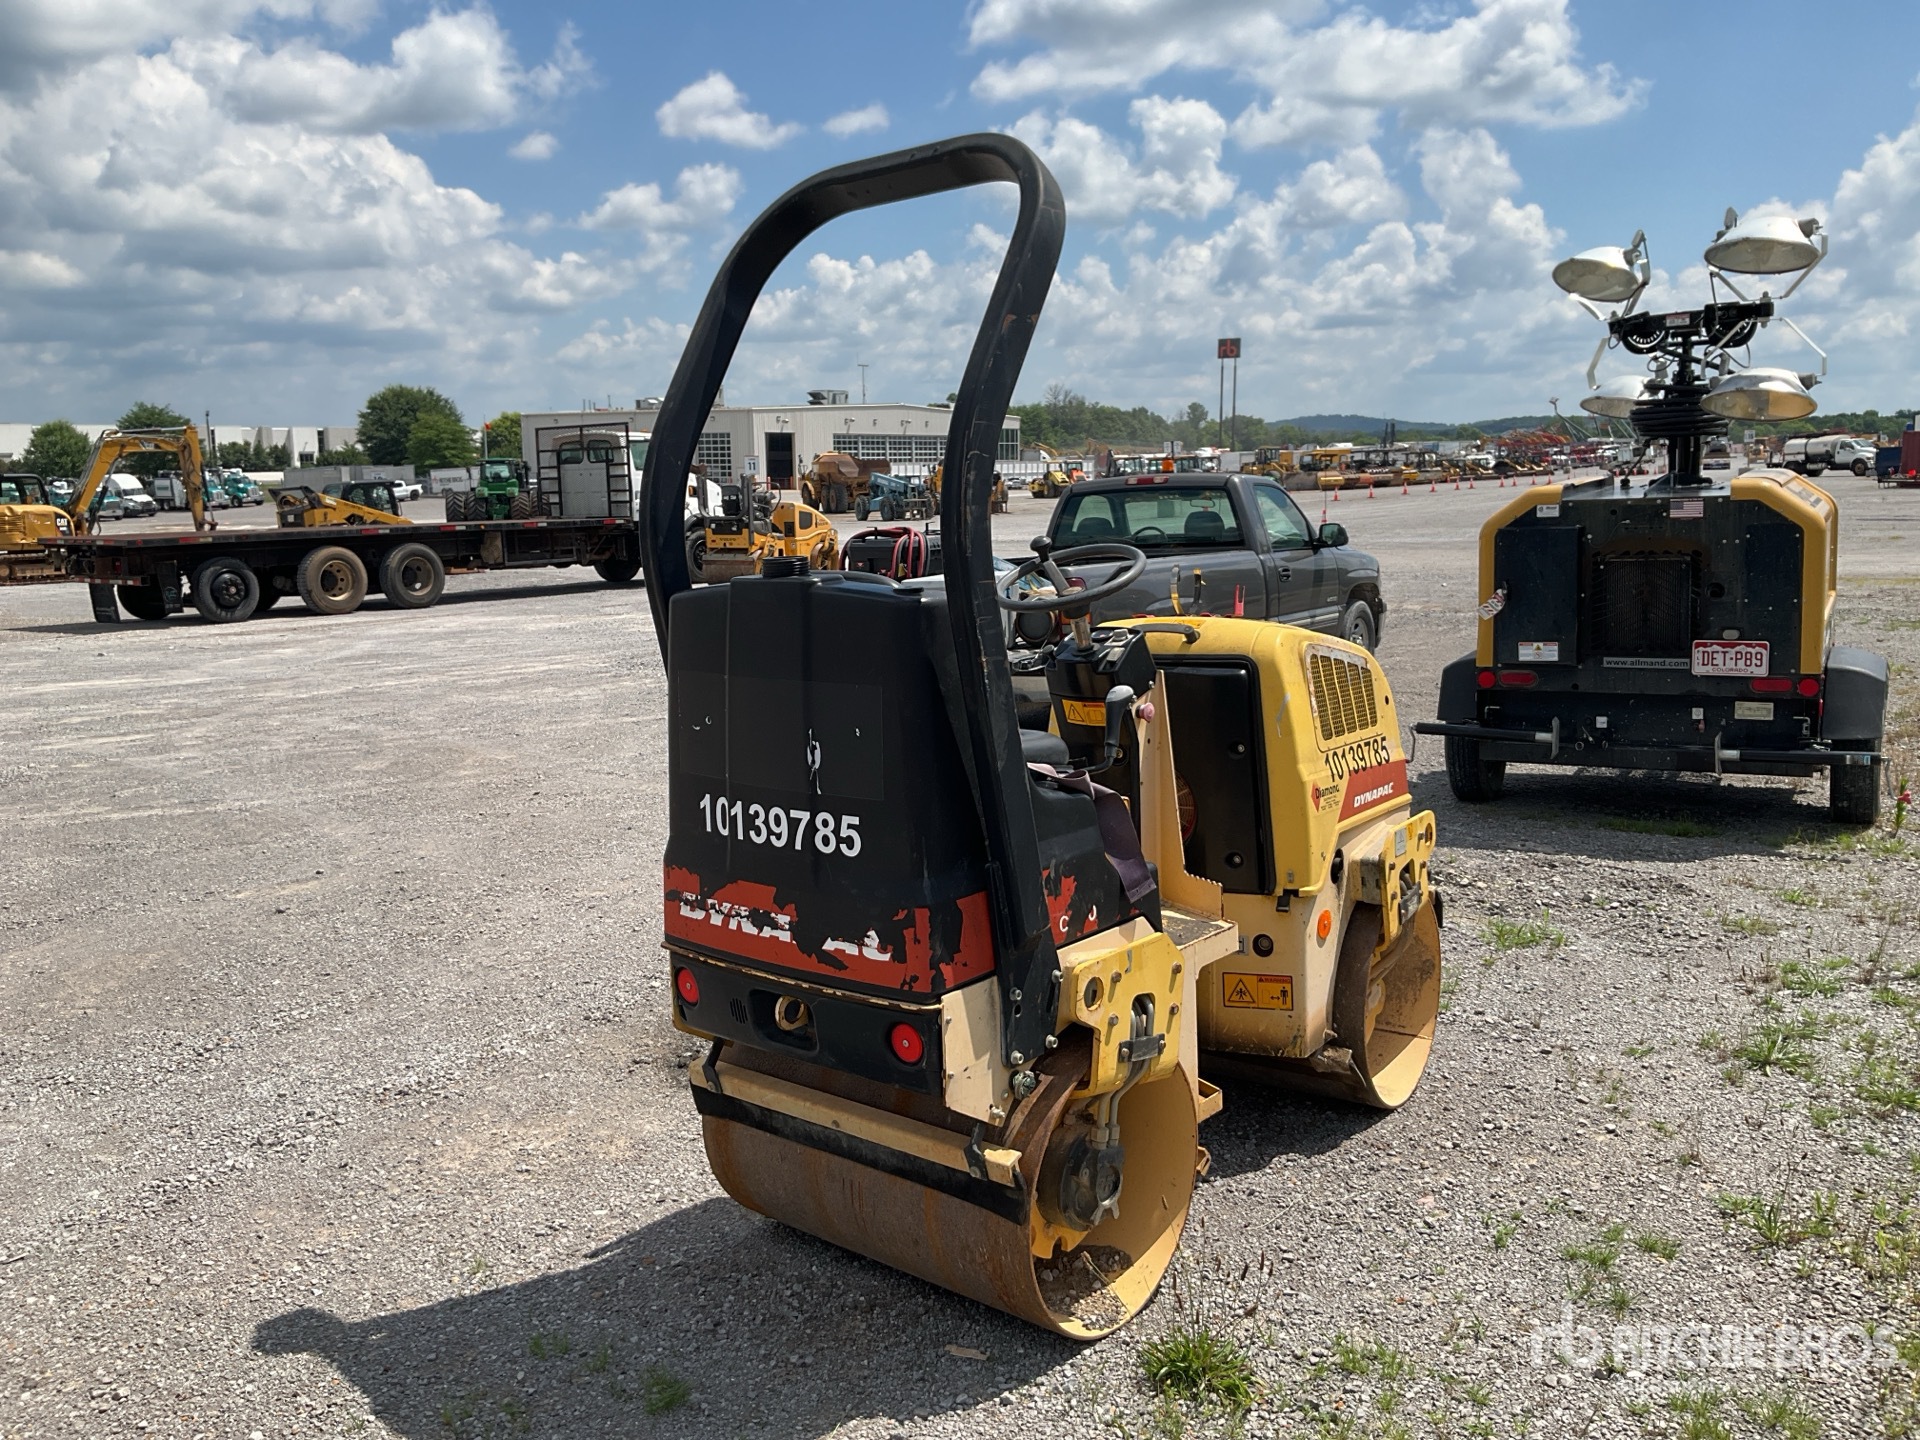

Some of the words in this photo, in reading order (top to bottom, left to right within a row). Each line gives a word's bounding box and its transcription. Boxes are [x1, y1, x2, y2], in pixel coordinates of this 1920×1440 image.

[1219, 338, 1238, 358] rb
[748, 461, 756, 471] 11
[56, 518, 68, 526] CAT
[1605, 659, 1689, 668] www.allmand.com
[1325, 737, 1390, 782] 10139785
[1353, 781, 1394, 808] DYNAPAC
[699, 793, 862, 858] 10139785
